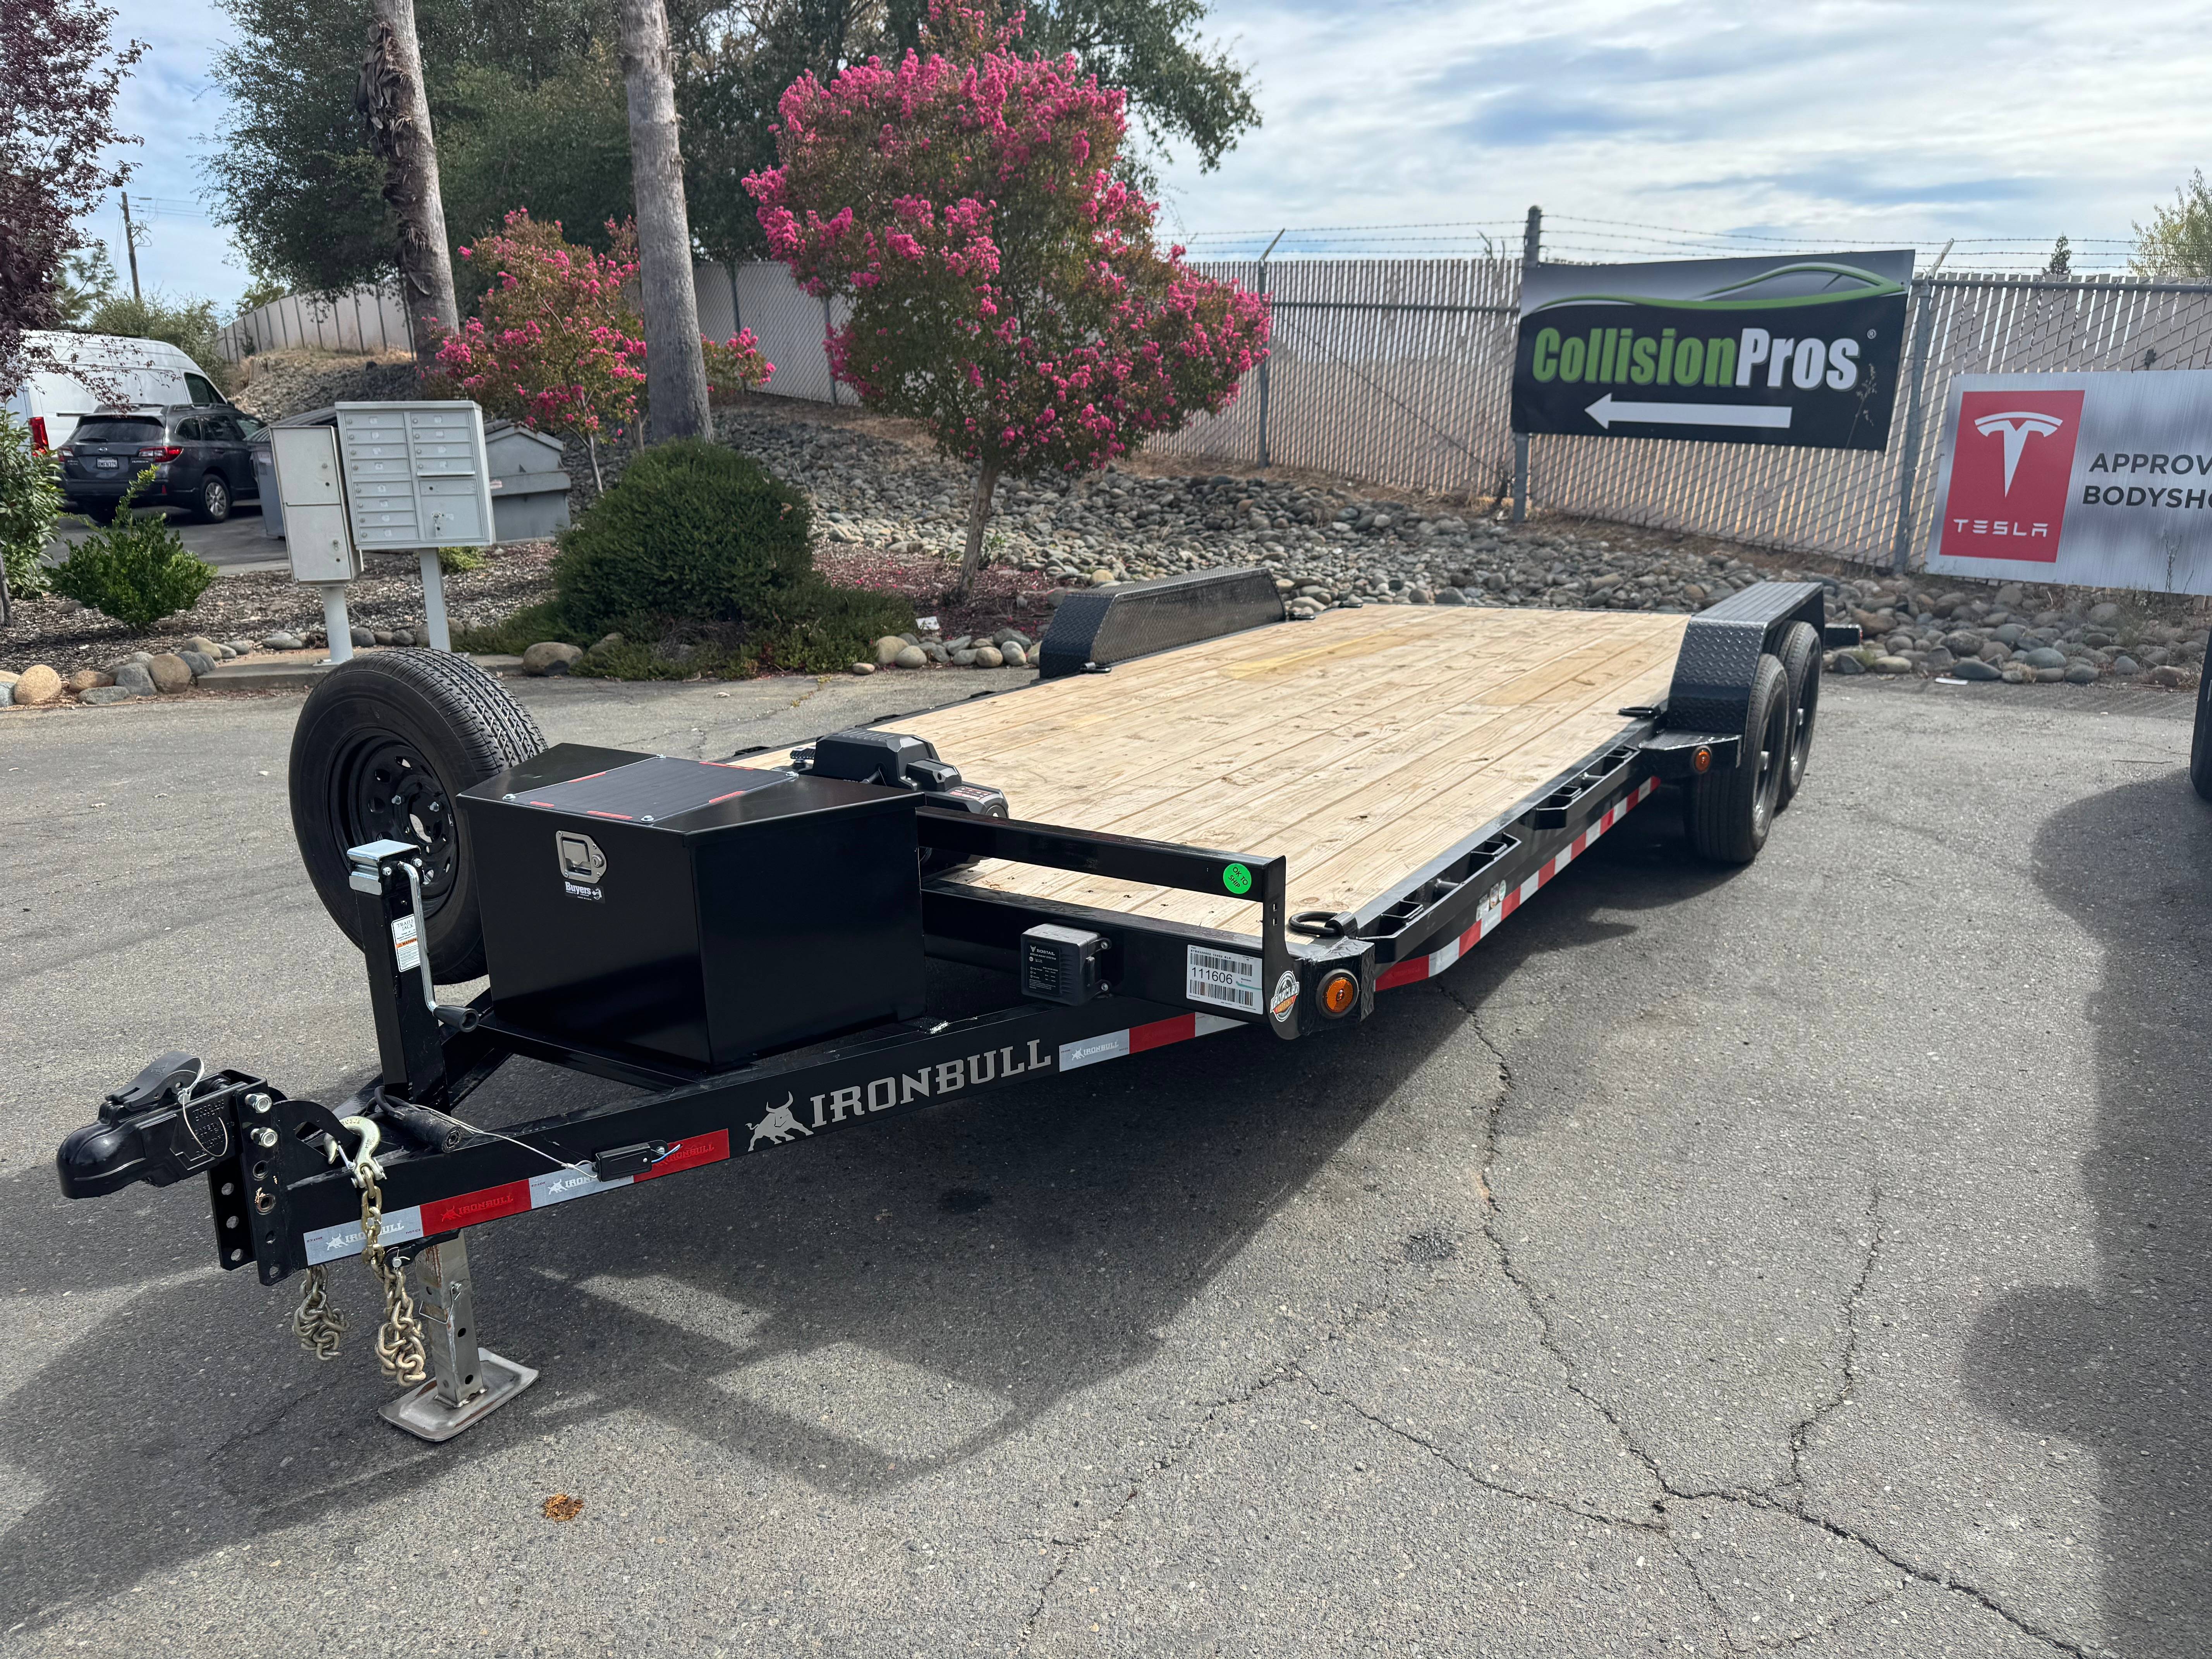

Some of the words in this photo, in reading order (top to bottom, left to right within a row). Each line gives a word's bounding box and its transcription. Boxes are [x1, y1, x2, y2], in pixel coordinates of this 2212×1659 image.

[1532, 327, 1859, 390] CollisionPros
[2089, 453, 2212, 476] APPROV
[2083, 486, 2212, 509] BODYSH
[1953, 519, 2048, 538] TESLA
[1228, 875, 1240, 887] SHIP
[1233, 867, 1242, 877] OK
[1240, 876, 1248, 885] TO
[565, 881, 591, 895] Buyers
[397, 919, 414, 928] TRAILE
[1192, 967, 1233, 984] 111606
[1084, 1041, 1119, 1056] IRONBULL
[811, 1039, 1051, 1128] IRONBULL
[458, 1195, 514, 1215] IRONBULL
[345, 1222, 404, 1243] IROULL
